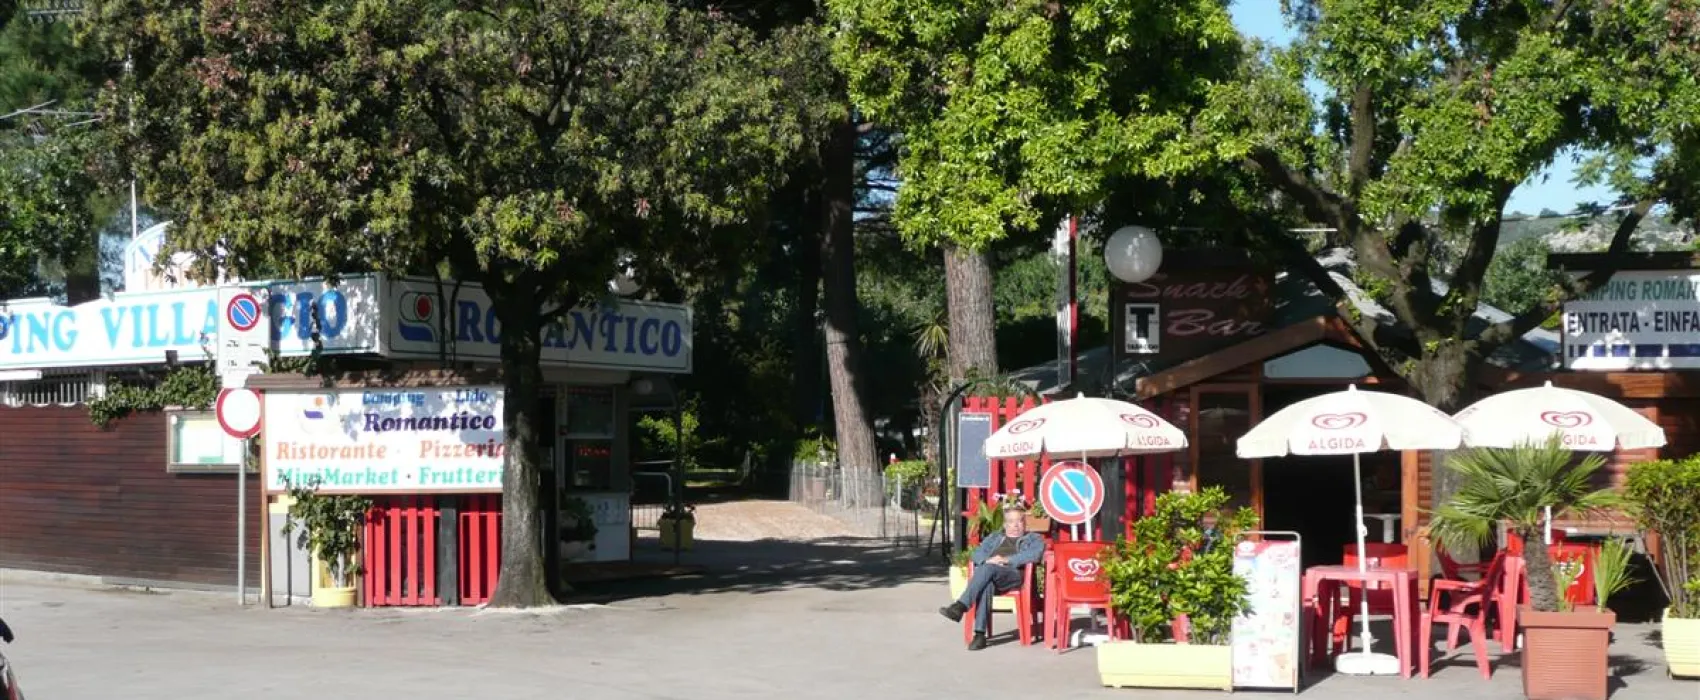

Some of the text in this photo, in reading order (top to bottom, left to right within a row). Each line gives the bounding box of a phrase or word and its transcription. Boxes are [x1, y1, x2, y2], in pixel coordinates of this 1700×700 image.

[1127, 272, 1254, 299] Snack
[1642, 279, 1700, 301] ROMAN
[100, 289, 348, 352] VILLAGIO
[456, 299, 683, 359] ROANTICO
[1129, 307, 1156, 339] T
[1166, 308, 1267, 337] Bar
[1568, 311, 1641, 333] ENTRATA
[362, 388, 489, 407] Camping Lido
[362, 410, 498, 432] Romantico
[275, 440, 387, 461] Ristorante
[1307, 438, 1366, 450] ALGIDA
[1563, 434, 1598, 447] GIDA
